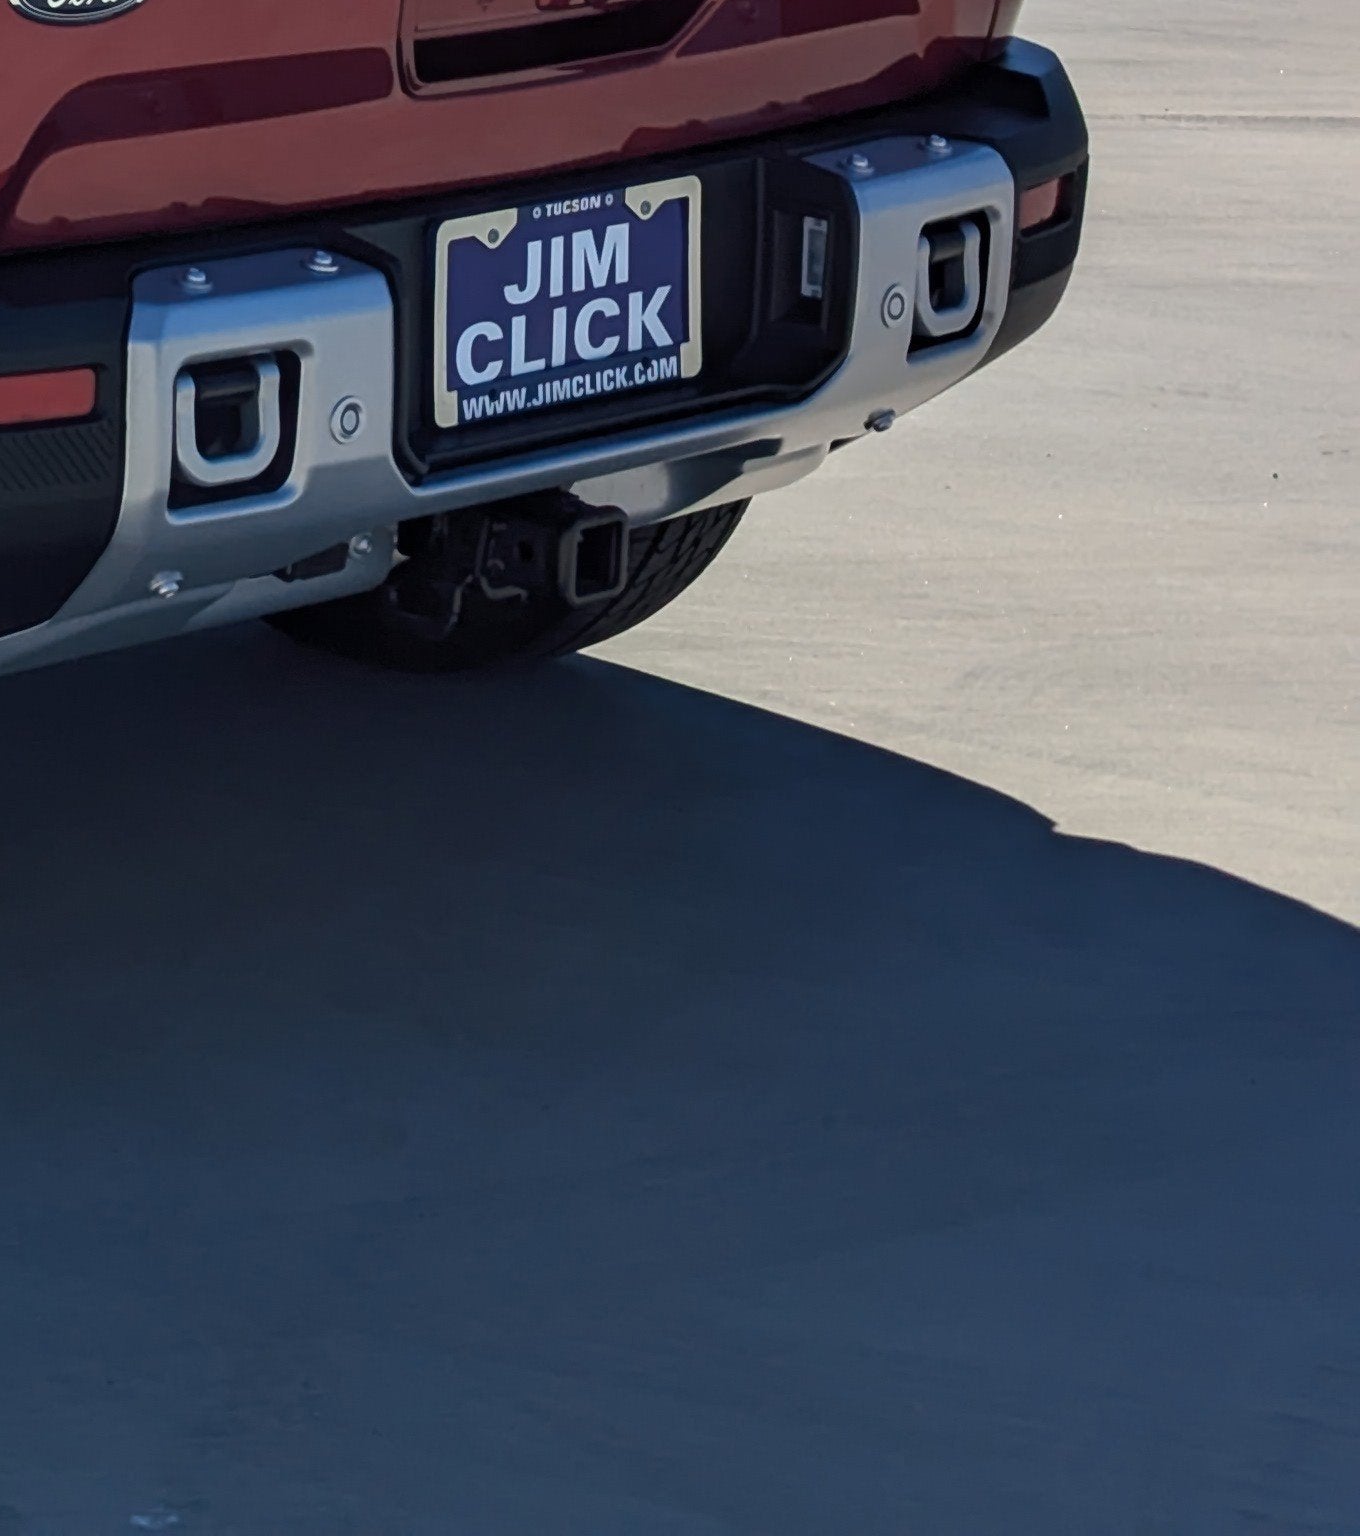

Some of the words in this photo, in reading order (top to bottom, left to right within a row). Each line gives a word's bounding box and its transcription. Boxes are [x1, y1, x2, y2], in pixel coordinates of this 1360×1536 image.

[544, 194, 602, 218] TUCSON
[502, 221, 631, 306] JIM
[455, 284, 675, 386] CLICK
[461, 355, 679, 421] WWW.JIMCLICK.COM
